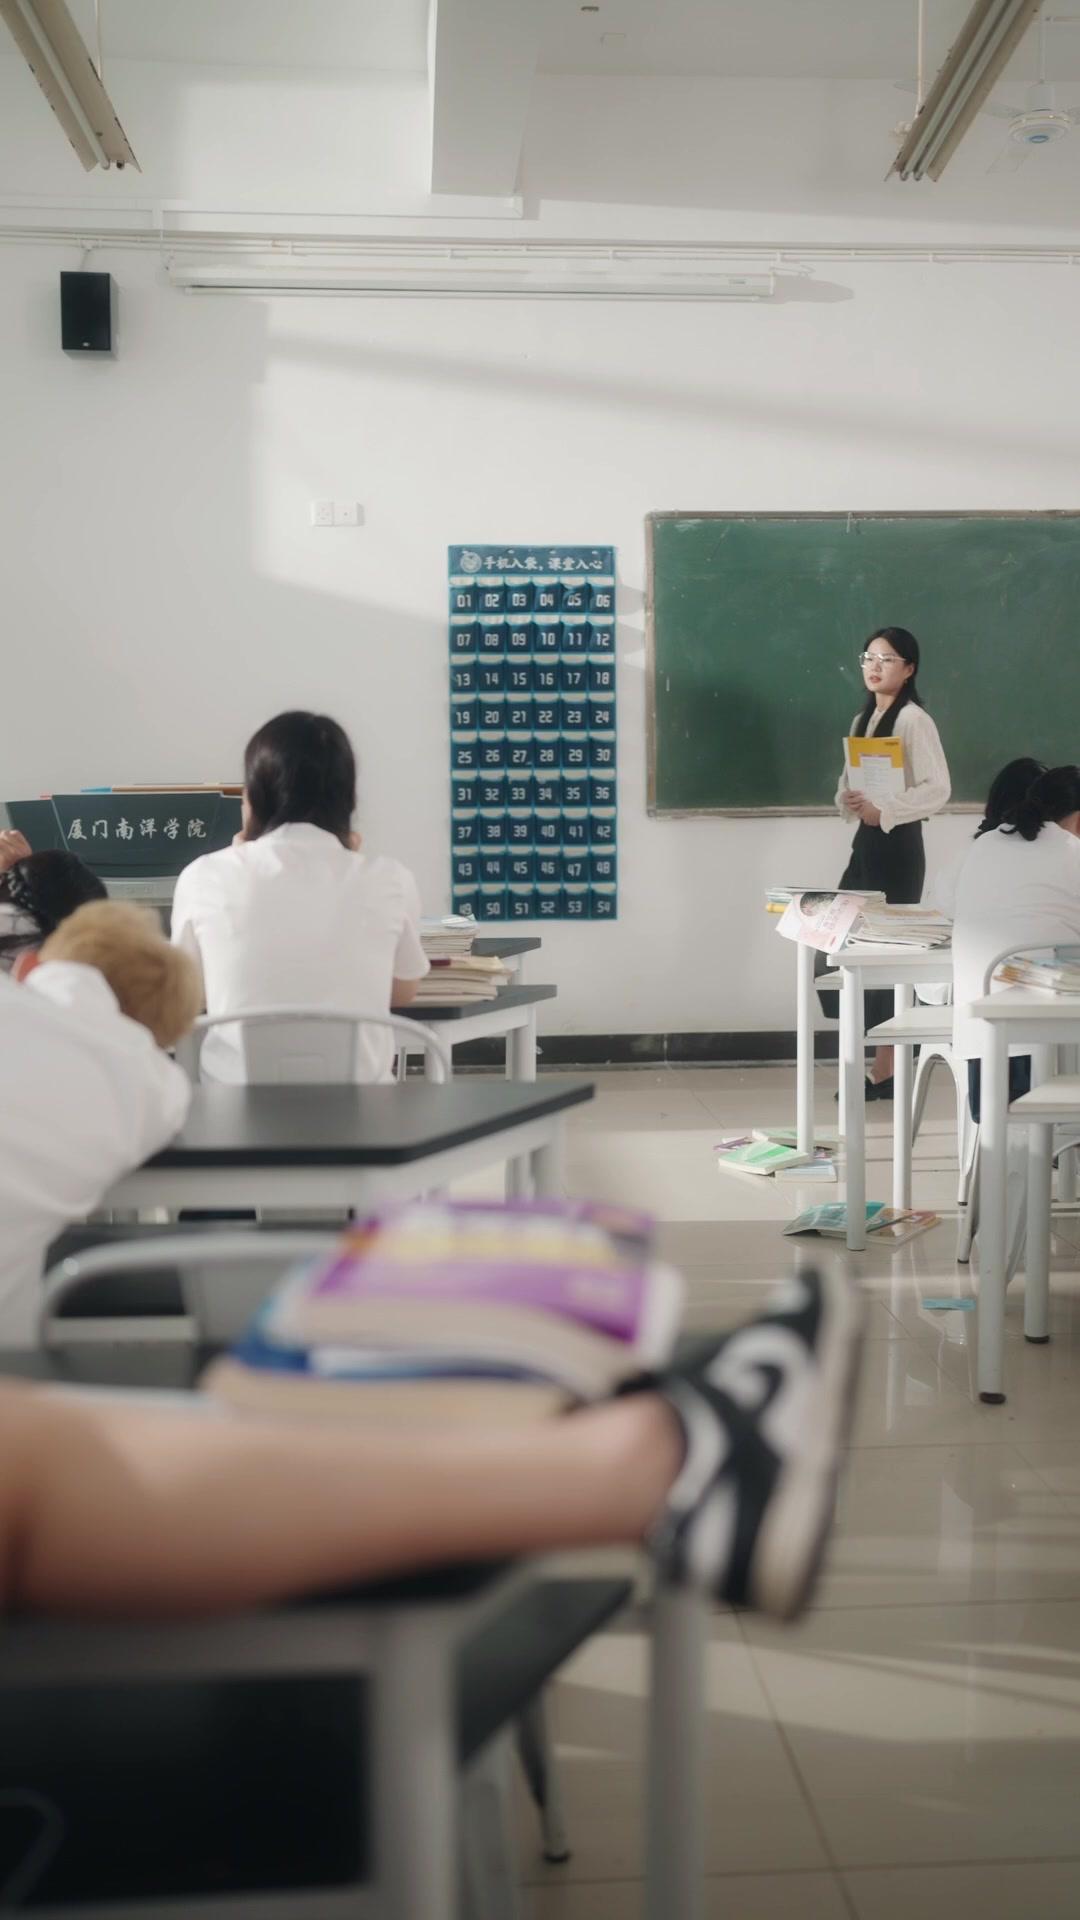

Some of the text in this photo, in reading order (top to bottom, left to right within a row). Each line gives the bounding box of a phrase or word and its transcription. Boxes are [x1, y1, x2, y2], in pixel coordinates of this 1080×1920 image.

[457, 593, 610, 607] 01 02 03 04 05 06
[457, 633, 610, 646] 07 08 09 10 11 12
[456, 672, 609, 686] 13 14 15 16 17 18
[456, 711, 609, 724] 19 20 21 22 23 24
[458, 749, 610, 763] 25 26 27 28 29 30
[458, 787, 609, 801] 31 32 33 34 35 36
[67, 817, 207, 841] 厦门南洋学院
[458, 825, 610, 838] 37 38 39 40 41 42
[458, 862, 610, 876] 43 44 45 46 47 48
[487, 903, 499, 914] 50
[515, 903, 528, 914] 51
[541, 902, 555, 913] 52
[568, 901, 582, 912] 53
[597, 901, 610, 912] 54
